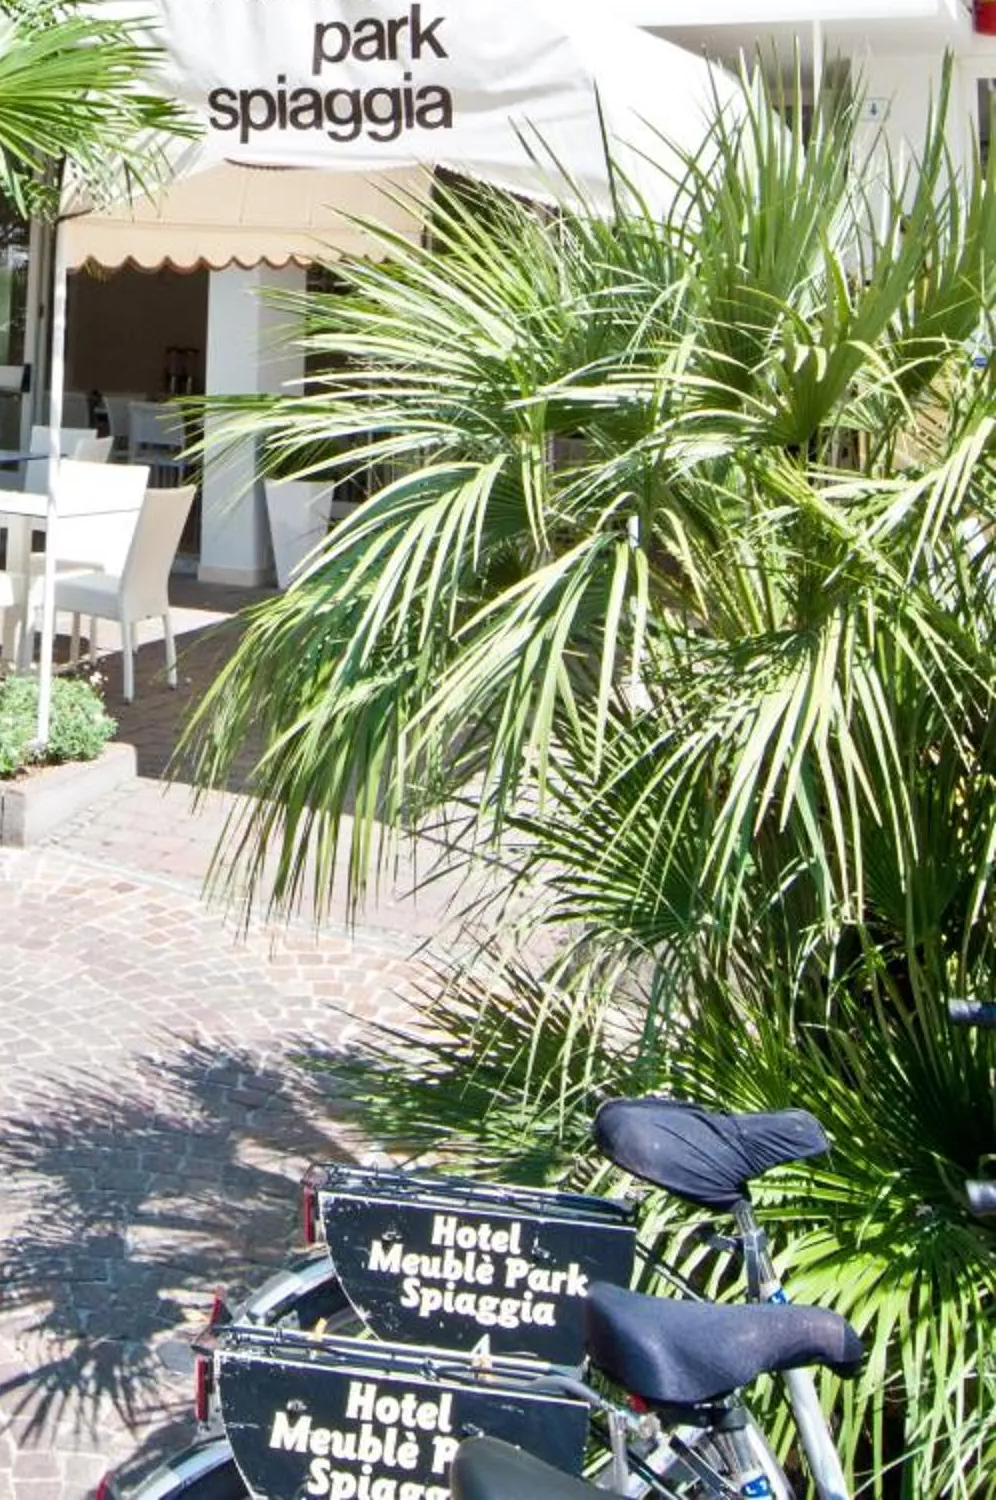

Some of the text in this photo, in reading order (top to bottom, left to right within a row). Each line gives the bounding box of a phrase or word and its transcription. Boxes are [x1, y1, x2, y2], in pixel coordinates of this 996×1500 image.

[312, 4, 448, 75] park
[208, 72, 453, 144] spiaggia
[431, 1214, 522, 1255] Hotel
[368, 1240, 589, 1298] Meublè Park
[400, 1277, 556, 1329] Spiaggia
[345, 1381, 453, 1433] Hotel
[268, 1411, 419, 1470] Meublè
